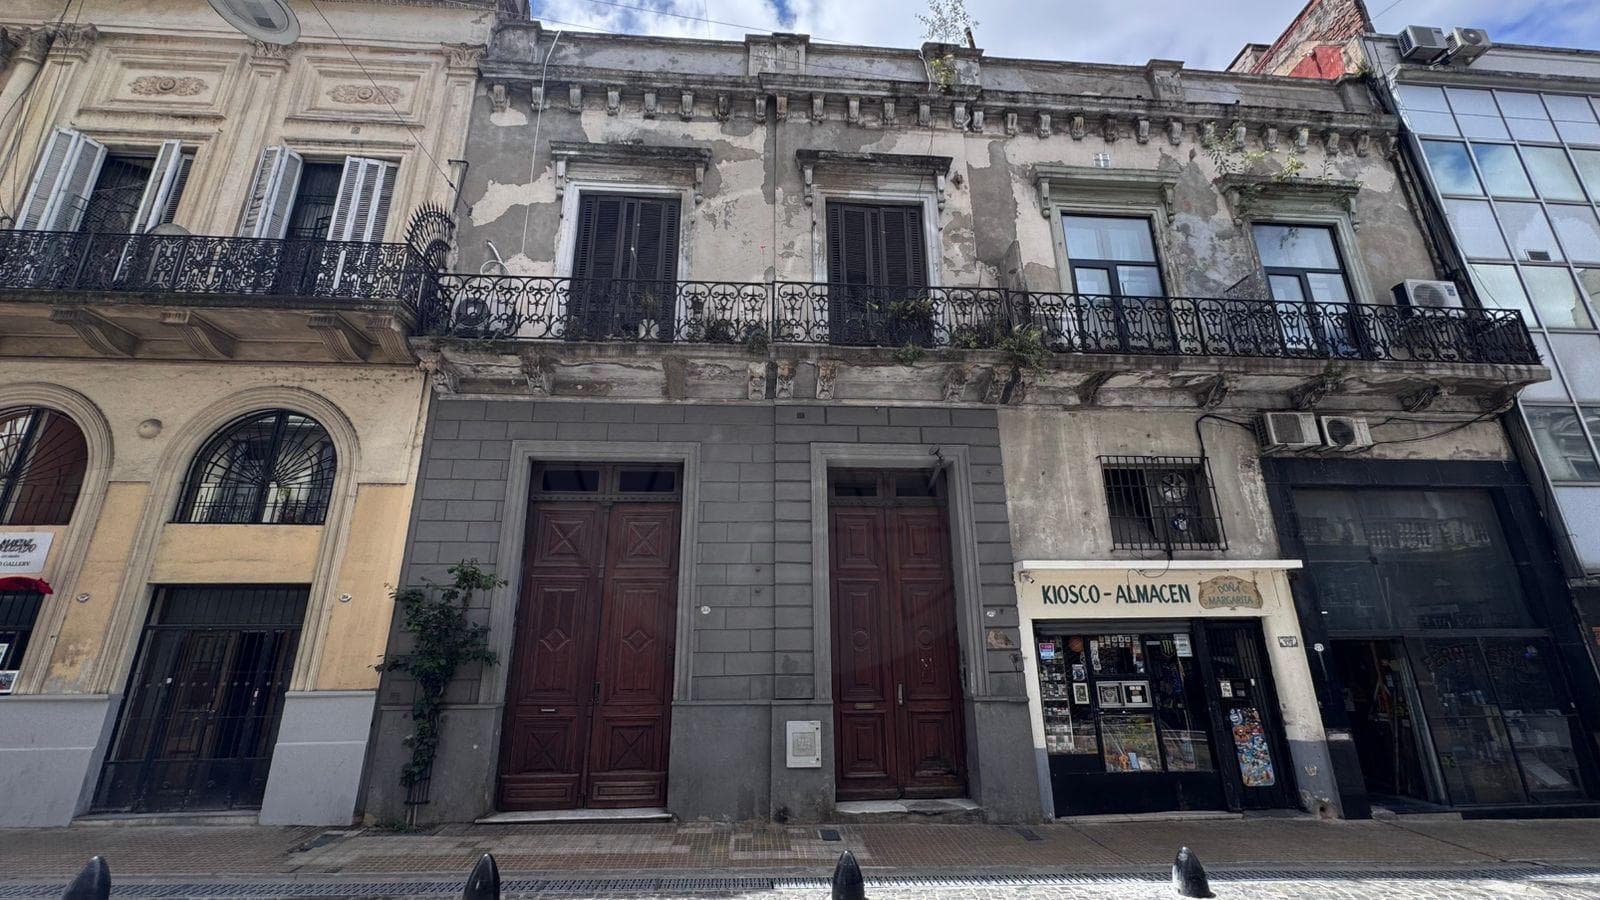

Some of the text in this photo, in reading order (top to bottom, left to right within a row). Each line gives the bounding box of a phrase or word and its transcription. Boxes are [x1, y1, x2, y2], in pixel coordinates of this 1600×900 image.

[1041, 584, 1100, 604] KIOSCO
[1116, 584, 1191, 604] ALMACEN
[1217, 582, 1241, 594] DOÑA
[1208, 595, 1254, 605] MARGARITA
